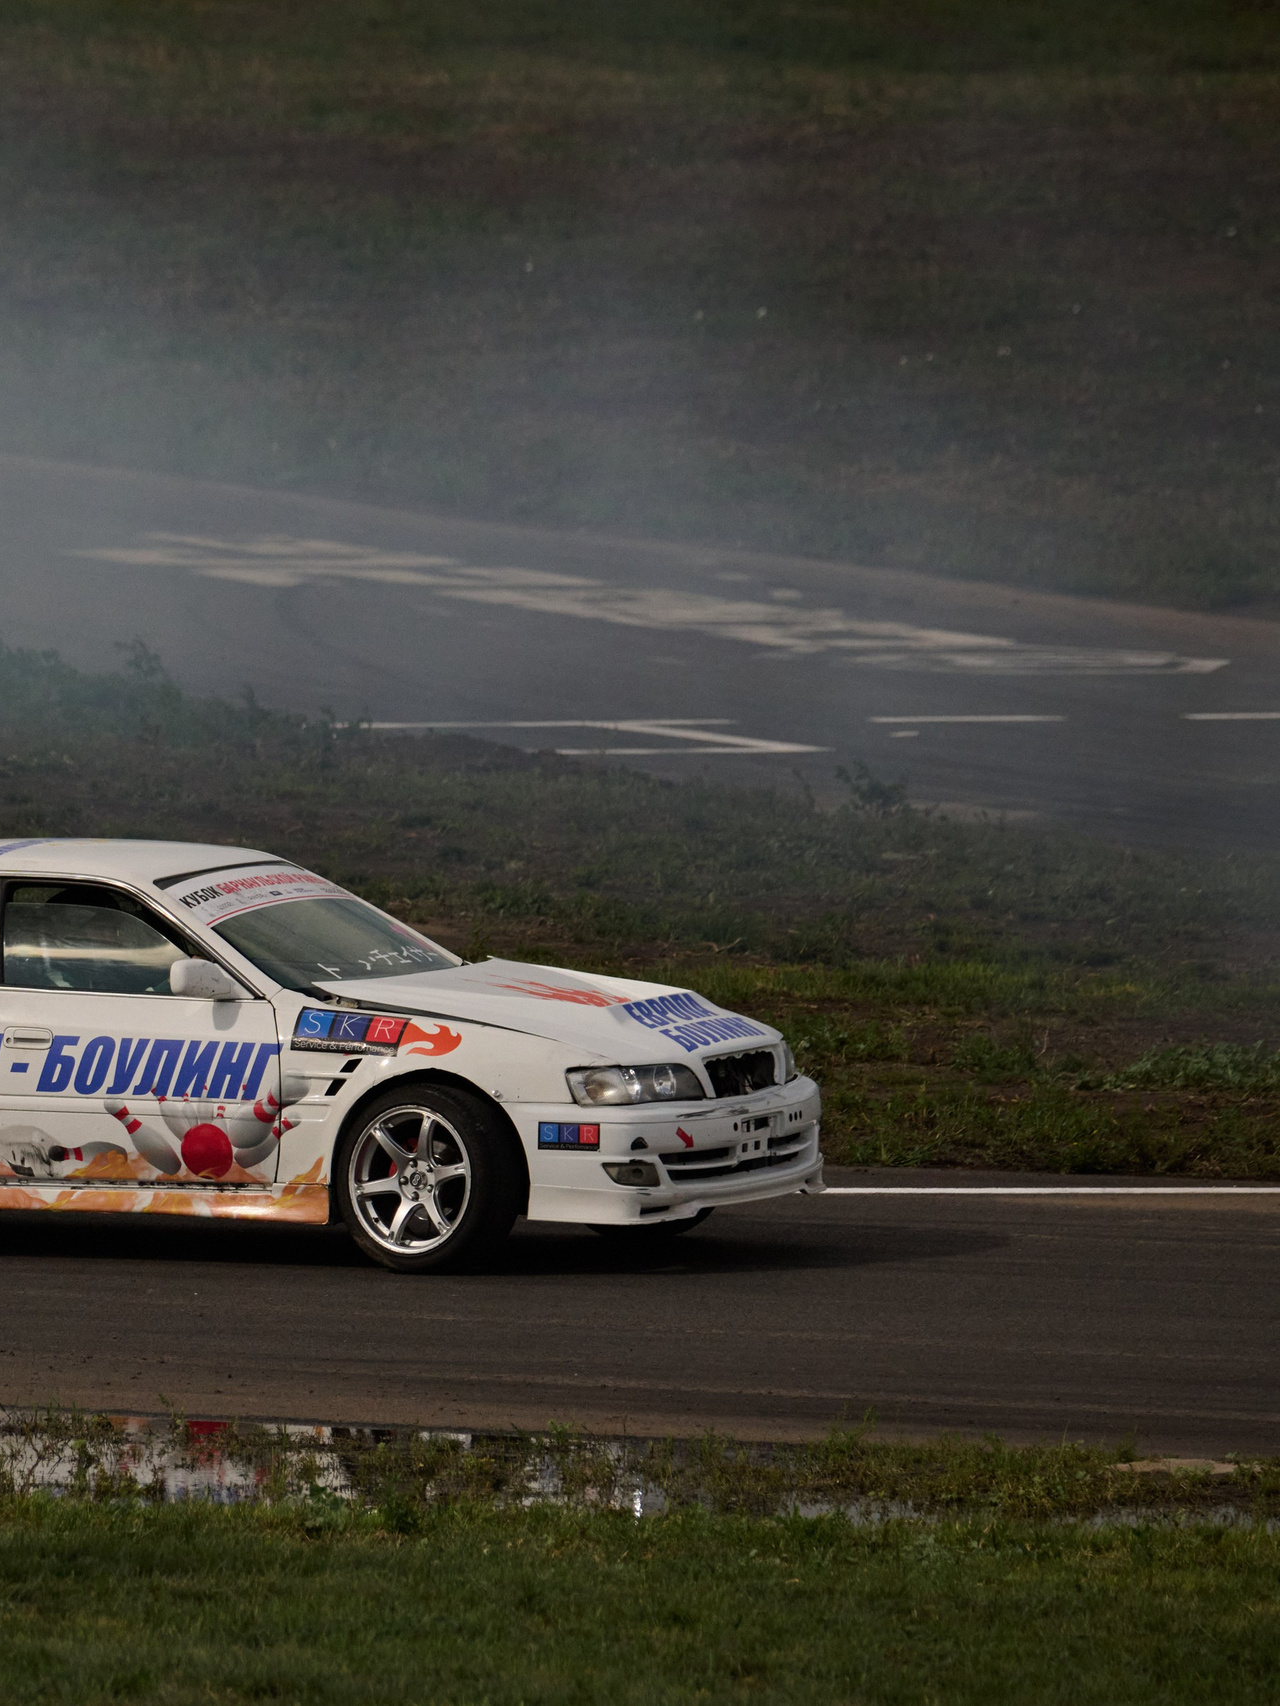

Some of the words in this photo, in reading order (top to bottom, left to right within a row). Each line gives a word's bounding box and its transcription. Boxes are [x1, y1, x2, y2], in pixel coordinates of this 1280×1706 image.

[179, 886, 224, 909] КУБОК
[622, 993, 719, 1029] ЕВРОПА
[304, 1012, 395, 1039] SKR
[659, 1017, 767, 1053] БОУЛИНГ
[294, 1040, 327, 1050] Service
[36, 1035, 284, 1100] БОУЛИНГ
[543, 1125, 594, 1141] SKR
